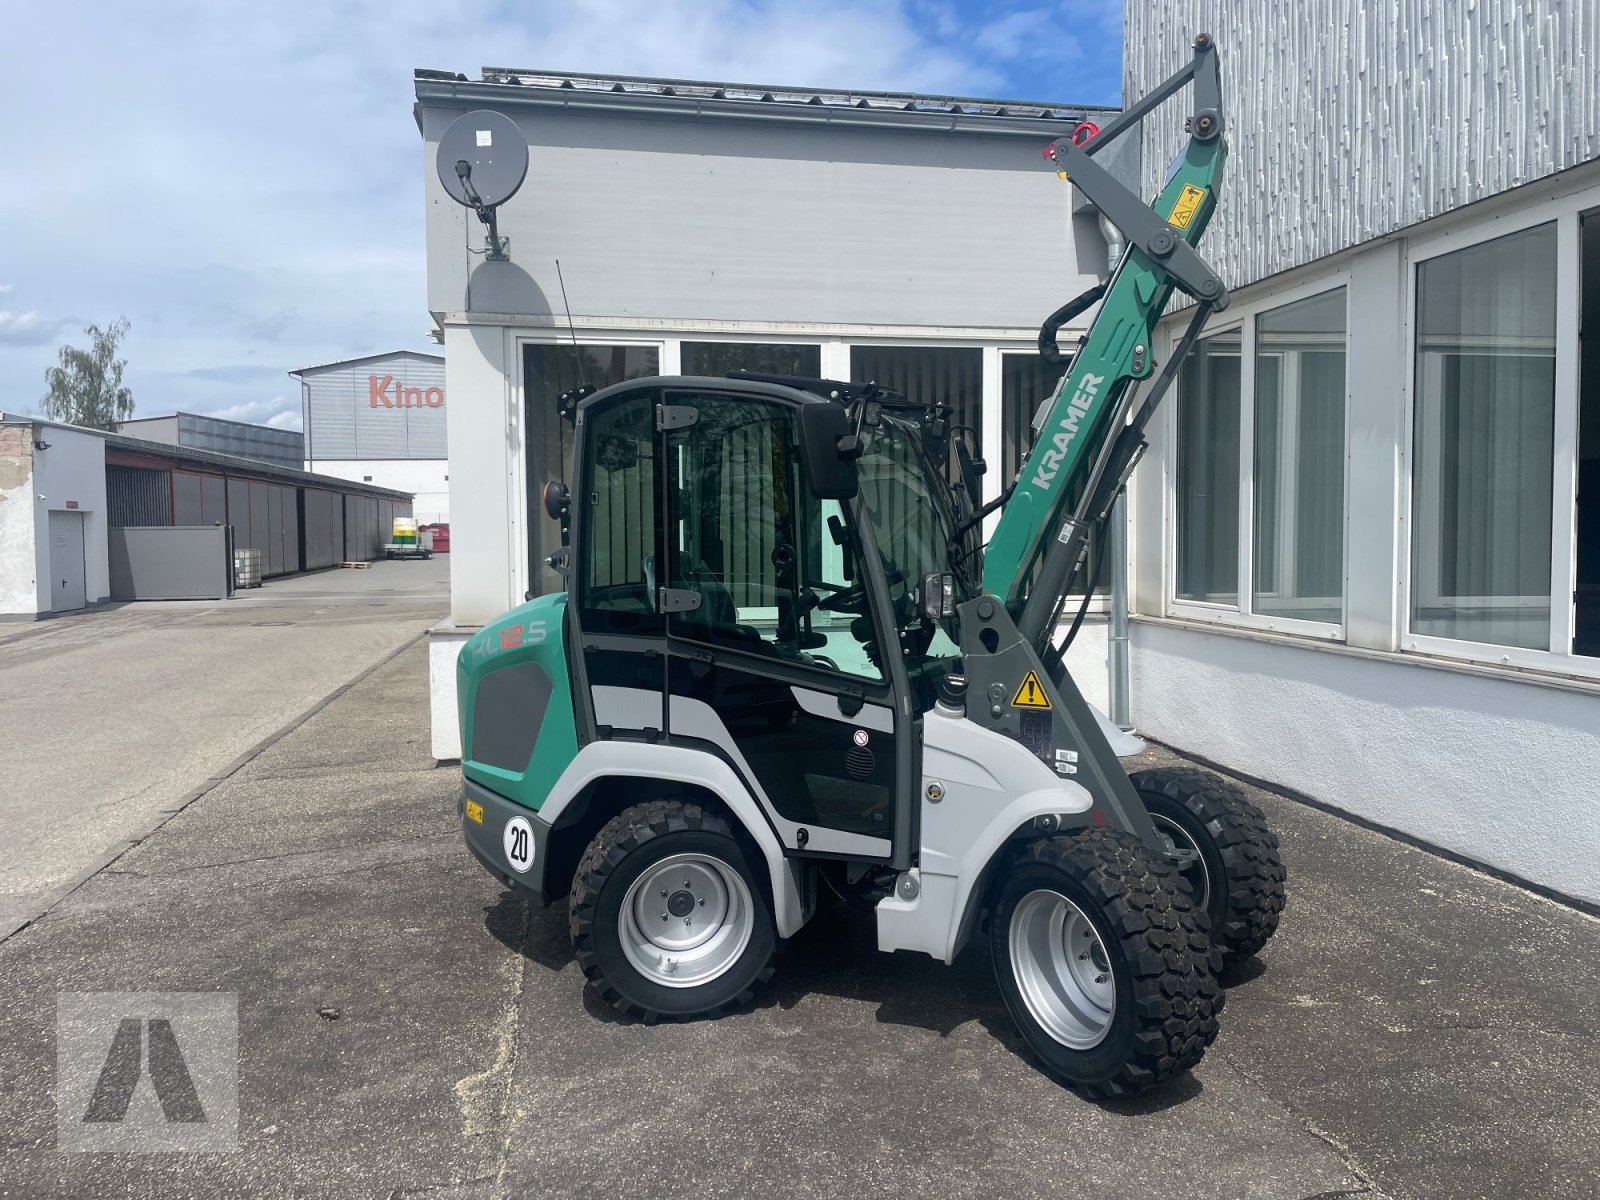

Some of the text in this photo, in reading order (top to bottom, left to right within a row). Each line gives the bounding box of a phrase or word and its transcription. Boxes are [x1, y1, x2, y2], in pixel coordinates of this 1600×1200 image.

[369, 375, 444, 408] Kino
[1031, 372, 1105, 490] KRAMER
[510, 826, 528, 863] 20
